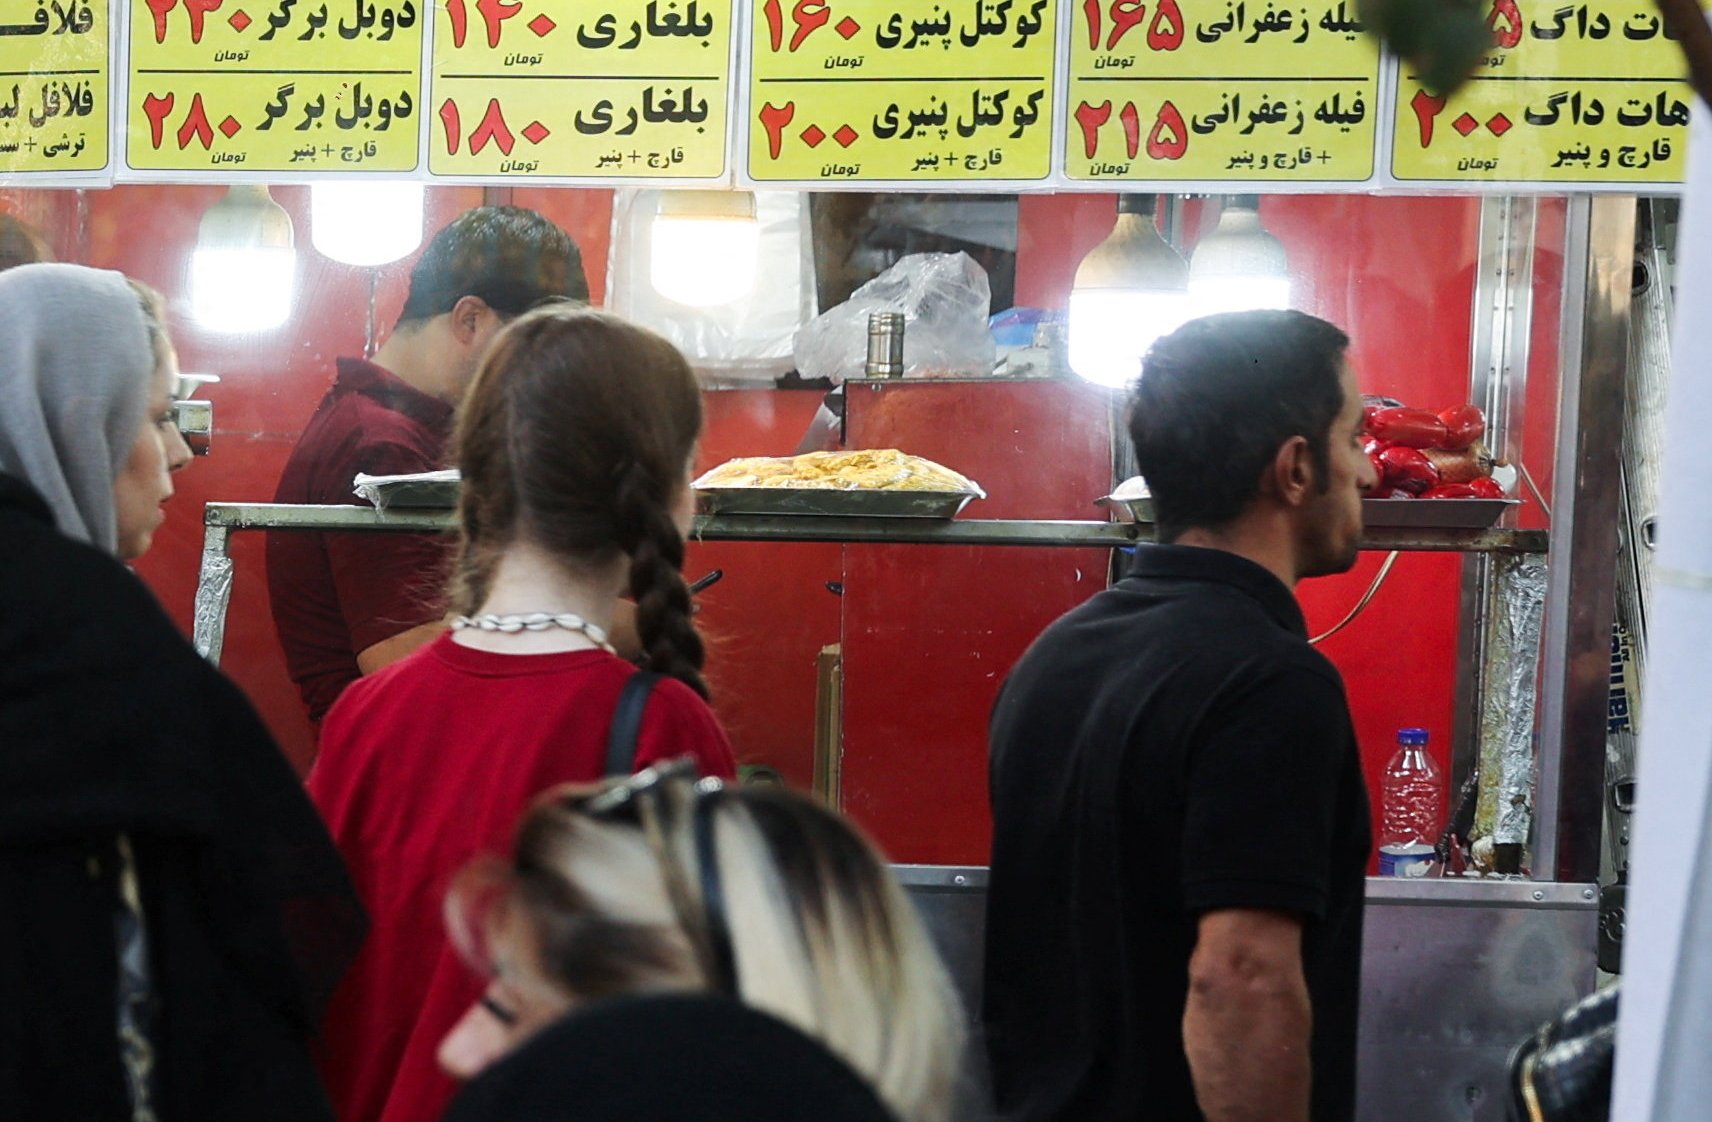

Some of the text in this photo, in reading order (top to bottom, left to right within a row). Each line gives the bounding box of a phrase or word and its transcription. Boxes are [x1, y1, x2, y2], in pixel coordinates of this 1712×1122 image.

[338, 0, 416, 42] دوبل
[576, 0, 713, 50] بلغاری
[763, 0, 1048, 53] کوکتل پنیری ۱۶۰
[1083, 0, 1368, 51] یله زعفرانی ۱۶۵
[1530, 4, 1611, 40] داگ
[214, 49, 249, 62] تومان
[503, 53, 543, 66] تومان
[824, 55, 865, 69] تومان
[1093, 55, 1135, 69] تومان
[28, 80, 94, 128] فلافل
[142, 82, 414, 151] دوبل برگر ۲۸۰
[439, 86, 709, 157] بلغاری ۱۸۰
[758, 89, 1045, 160] کوکتل پنیری ۲۰۰
[1074, 90, 1366, 160] فیله زعفرانی ۲۱۵
[1411, 89, 1691, 149] هات داگ ۲۰۰
[42, 134, 86, 158] ترشی
[289, 142, 317, 163] پنیر
[340, 141, 377, 163] قارچ
[1550, 138, 1672, 169] قارچ و پنیر
[211, 151, 246, 164] تومان
[499, 159, 539, 173] تومان
[594, 149, 623, 170] پنیر
[647, 148, 684, 169] قارچ
[911, 151, 940, 172] پنیر
[964, 149, 1002, 171] قارچ
[1225, 149, 1254, 170] پنیر
[1260, 155, 1268, 169] و
[1274, 147, 1312, 170] قارچ
[1457, 157, 1499, 171] تومان
[820, 163, 860, 177] تومان
[1089, 162, 1130, 176] تومان
